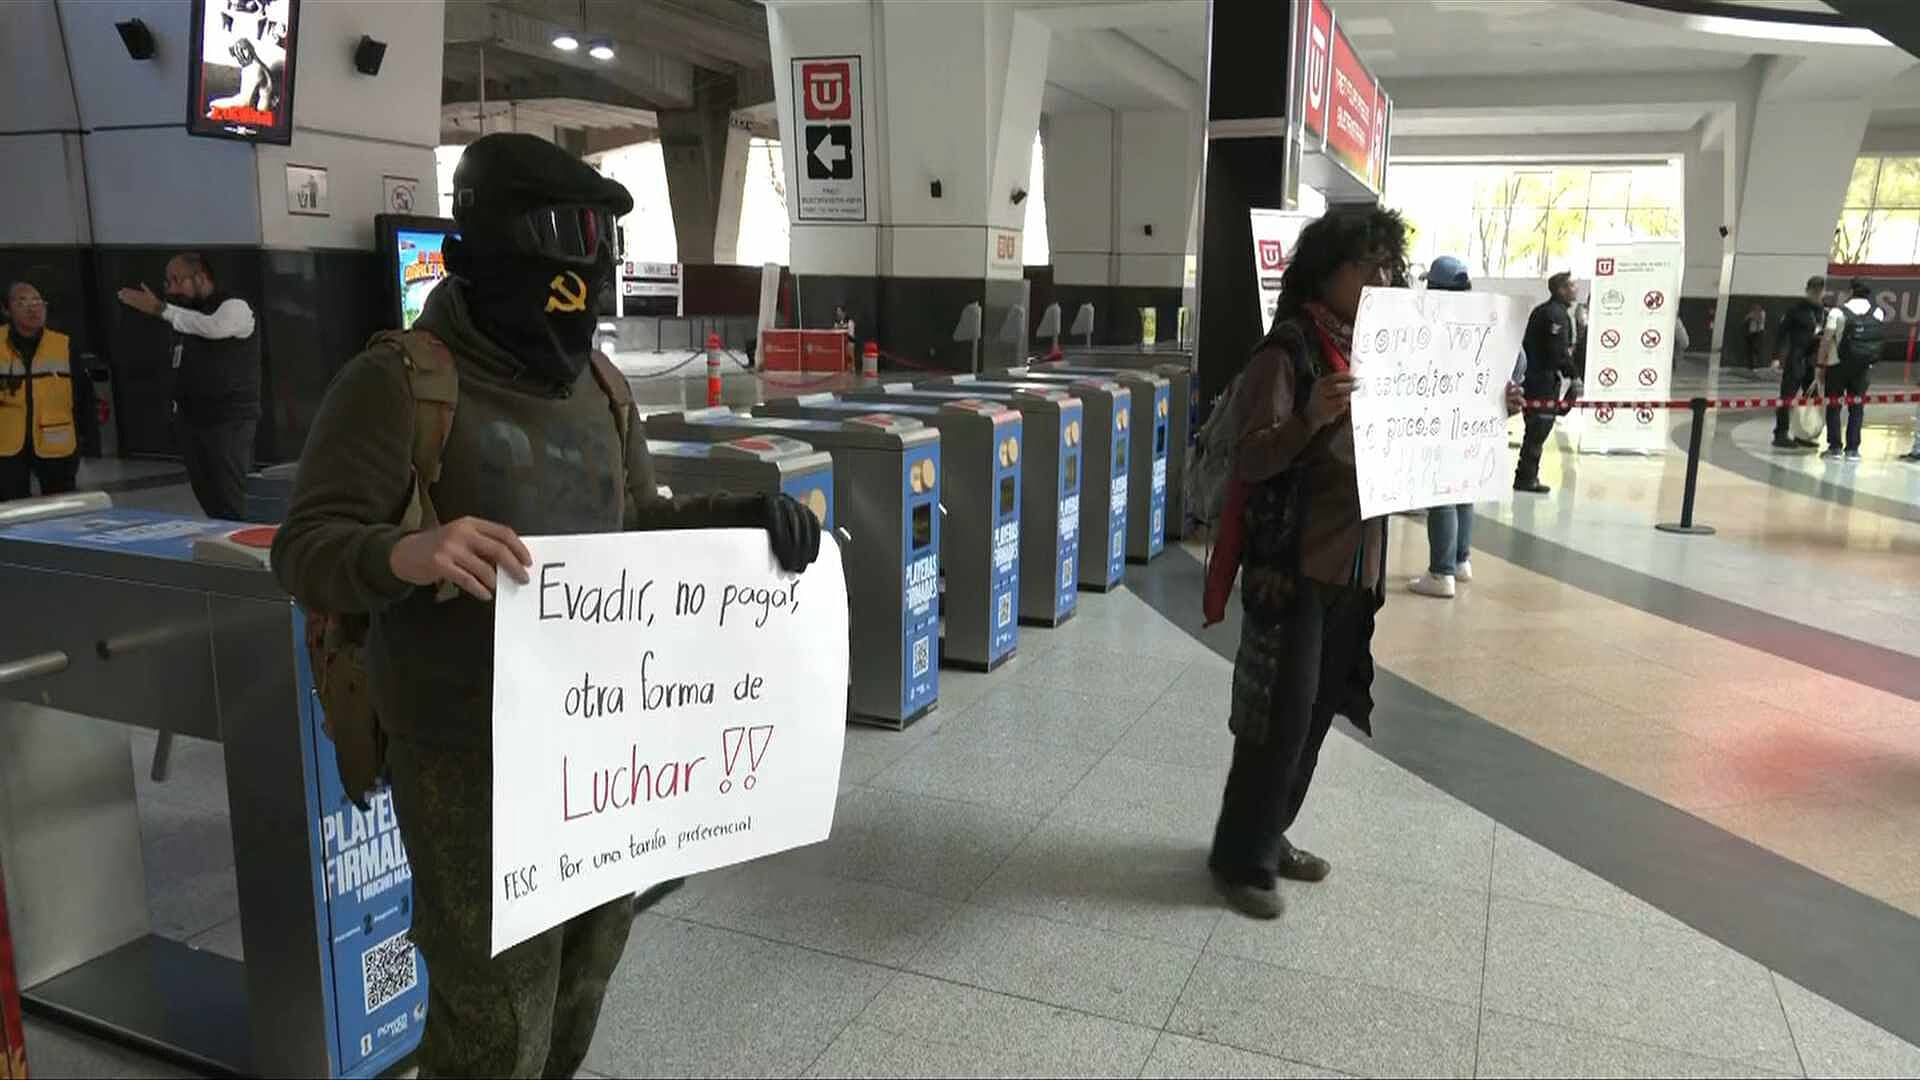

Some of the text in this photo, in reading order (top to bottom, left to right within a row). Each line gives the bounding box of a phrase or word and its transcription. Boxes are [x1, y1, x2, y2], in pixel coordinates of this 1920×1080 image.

[539, 562, 801, 629] Evadir, no pagar,
[564, 650, 764, 719] otra forma de
[563, 744, 707, 823] Luchar
[503, 866, 538, 901] FESC
[559, 855, 584, 883] Por
[593, 849, 622, 870] una
[629, 826, 667, 860] tarifa
